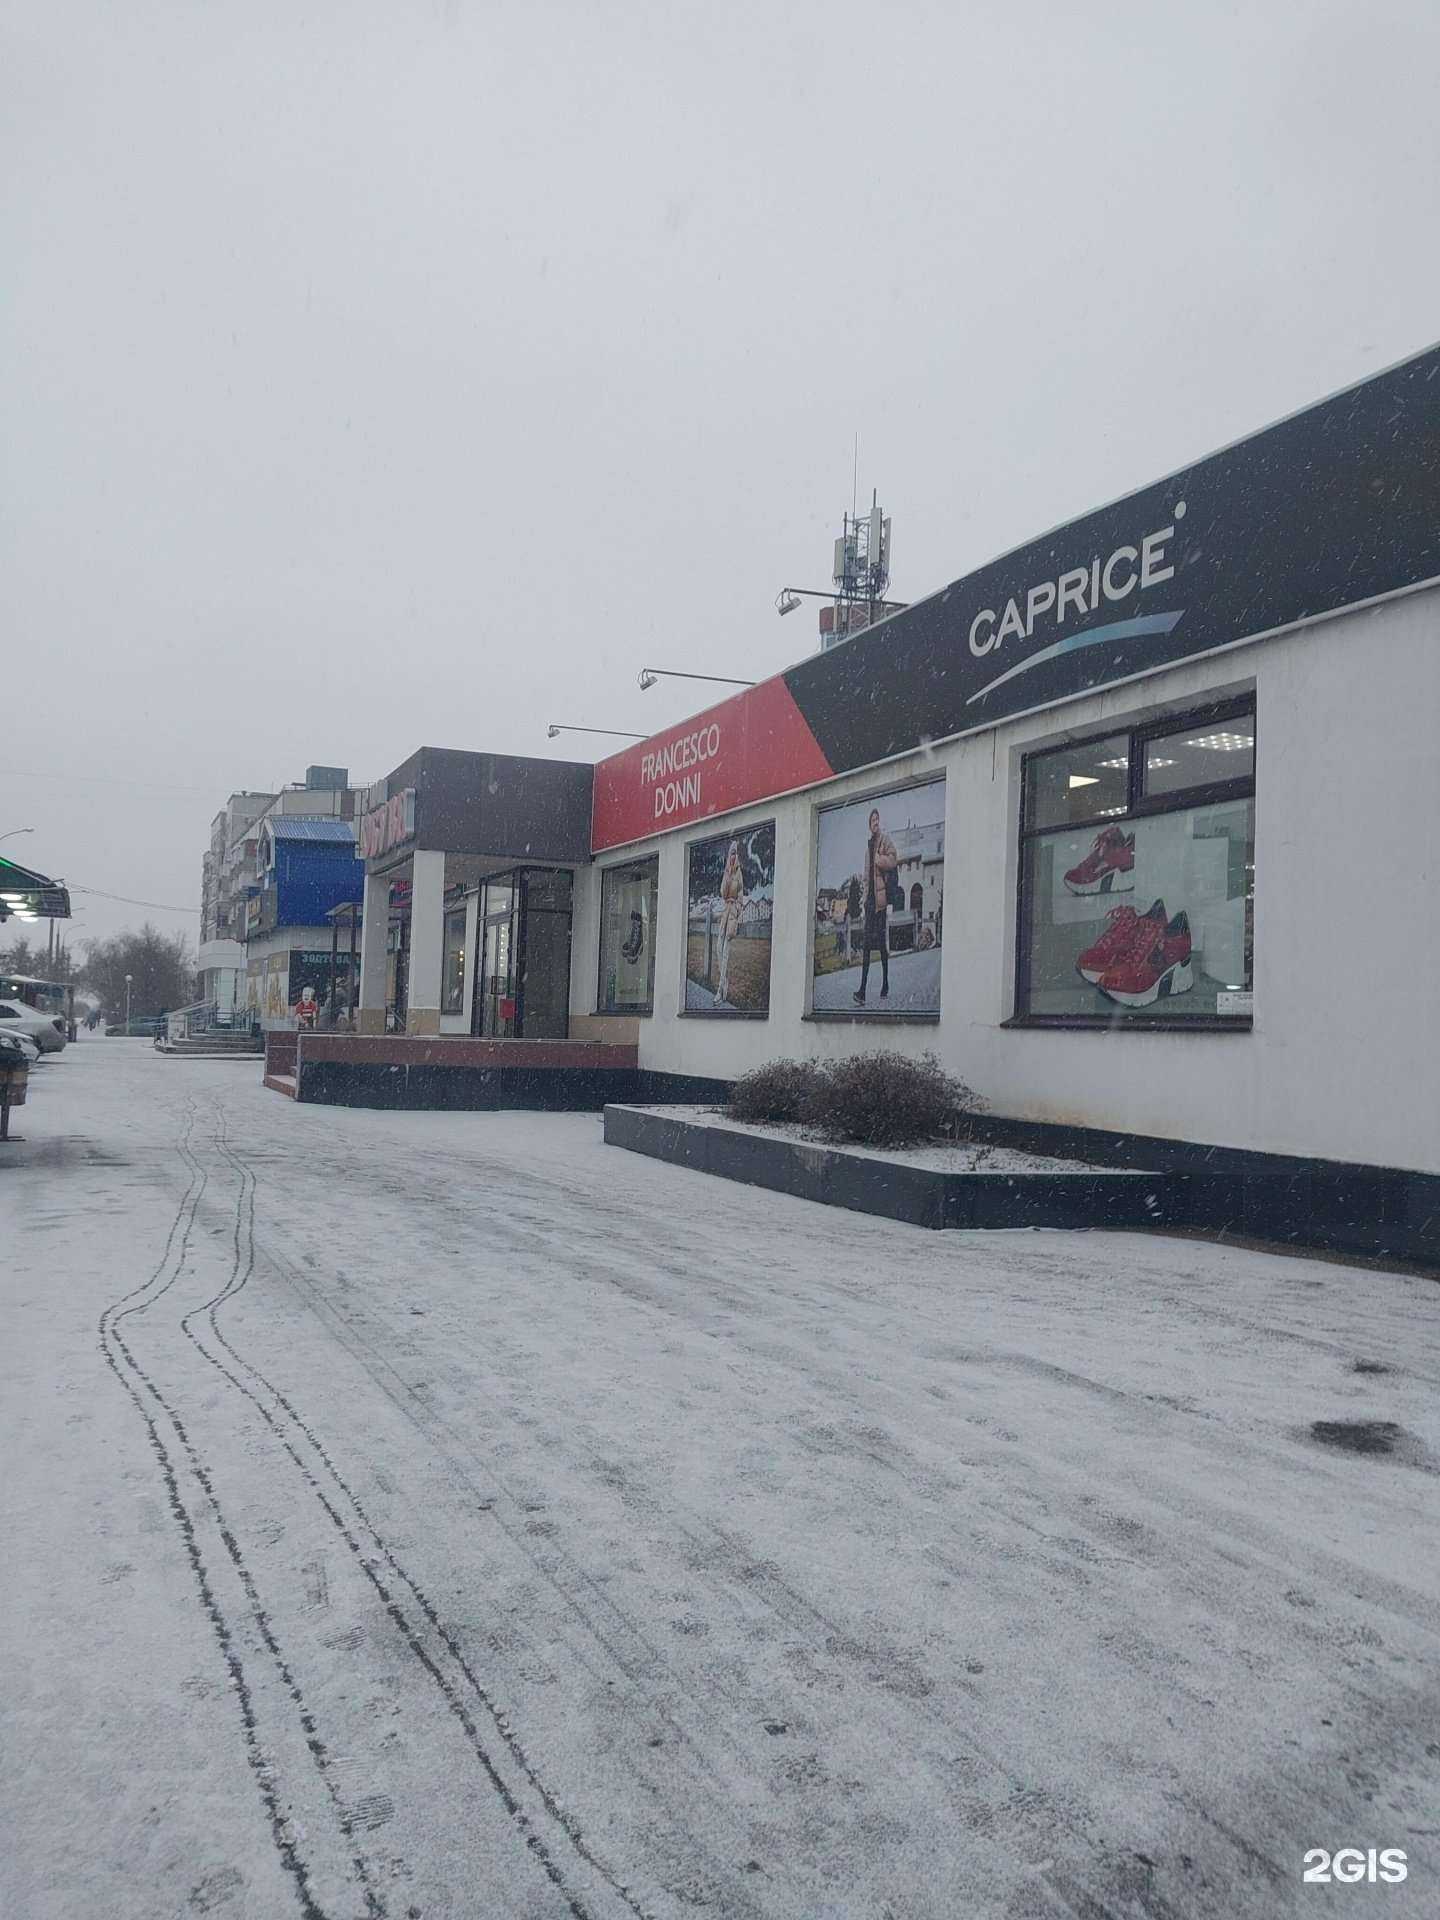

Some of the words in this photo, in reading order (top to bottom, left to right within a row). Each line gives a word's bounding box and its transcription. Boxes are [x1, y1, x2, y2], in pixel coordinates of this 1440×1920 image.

[969, 526, 1175, 657] CAPRICE
[640, 723, 720, 785] FRANCESCO
[654, 771, 701, 818] DONNI
